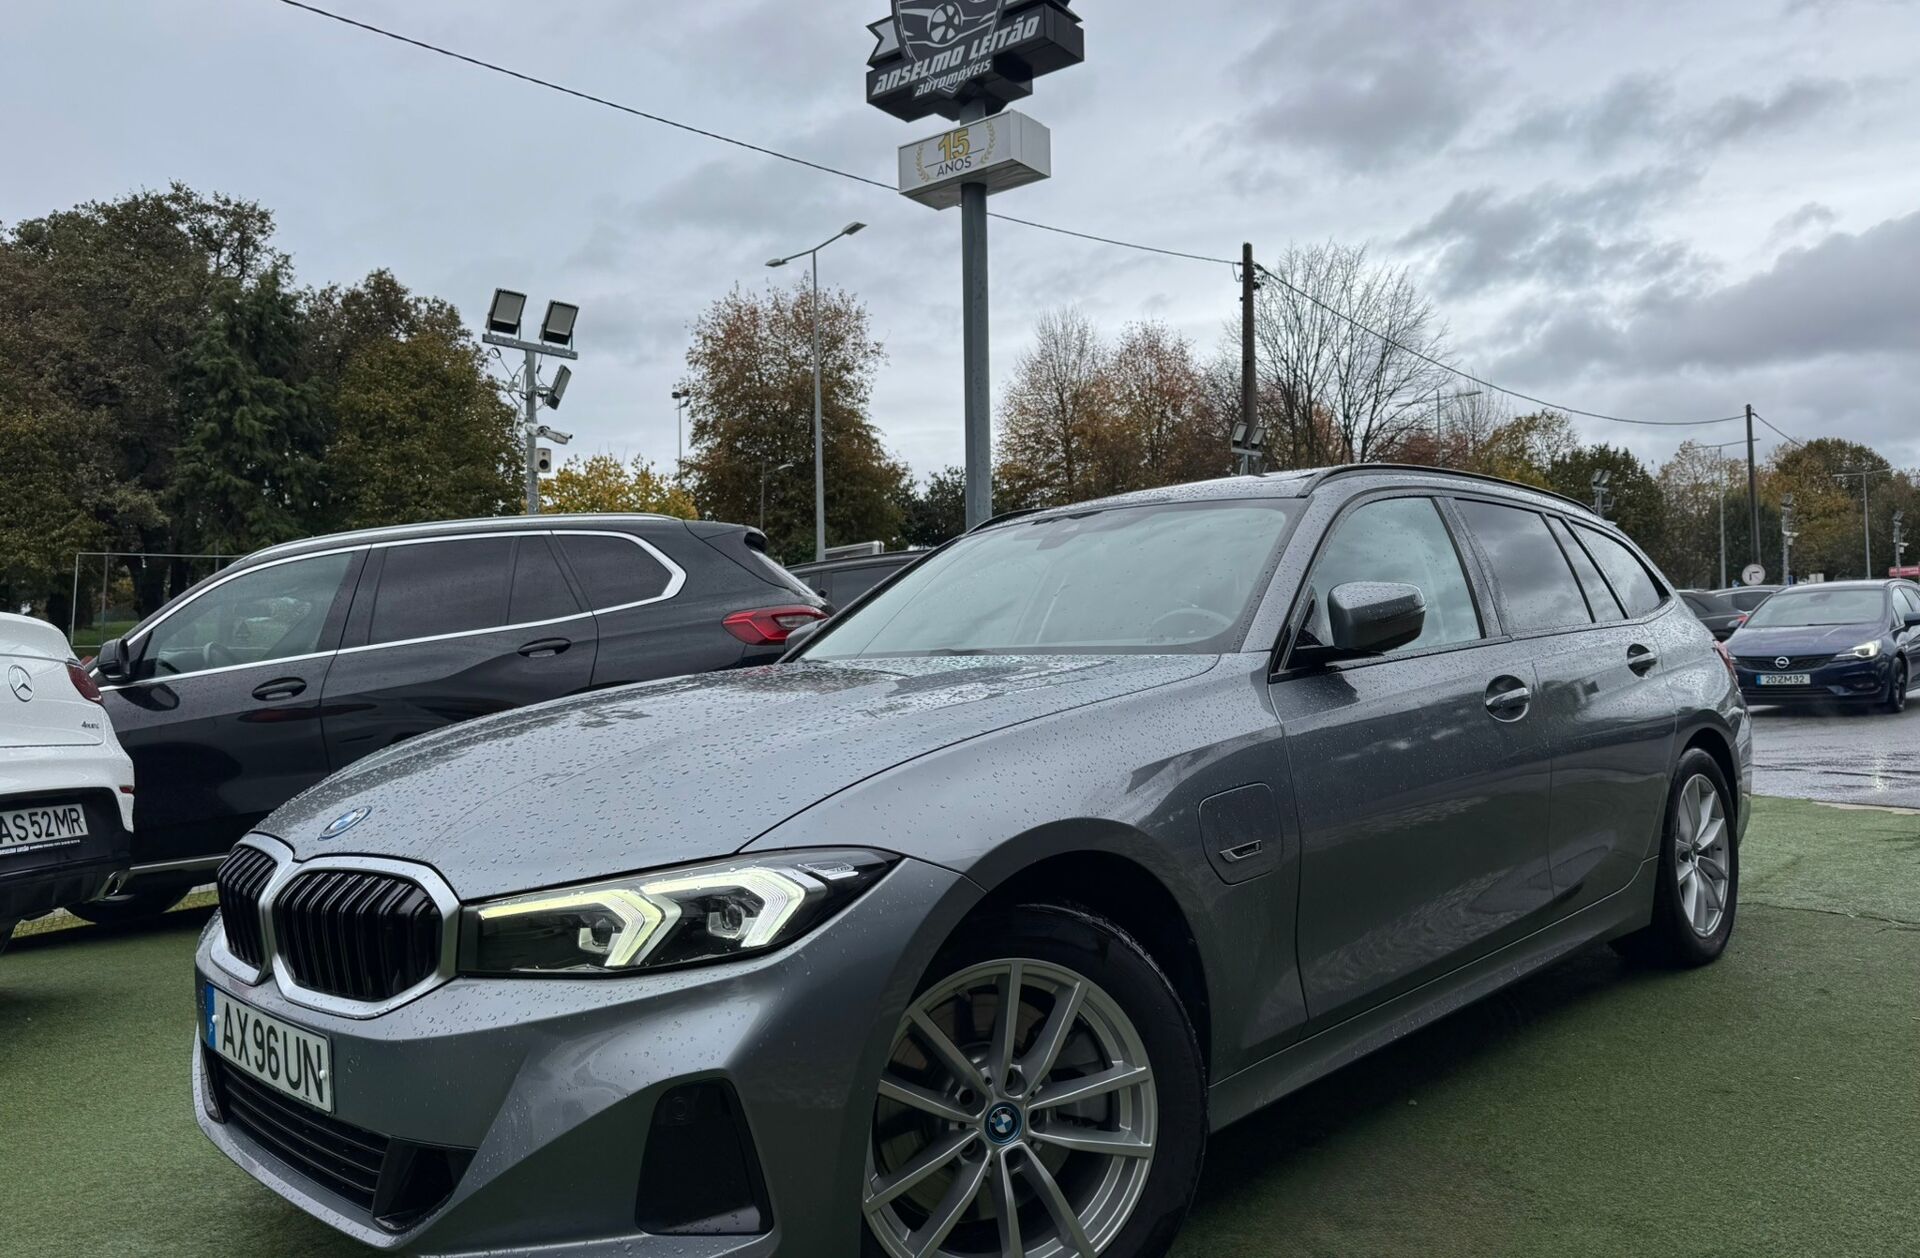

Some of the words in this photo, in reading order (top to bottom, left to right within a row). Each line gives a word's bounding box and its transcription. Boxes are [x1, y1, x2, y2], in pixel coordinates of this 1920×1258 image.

[938, 127, 970, 161] 15
[936, 156, 973, 177] ANOS
[0, 808, 83, 844] AS52MR
[222, 1002, 324, 1103] AX96UN
